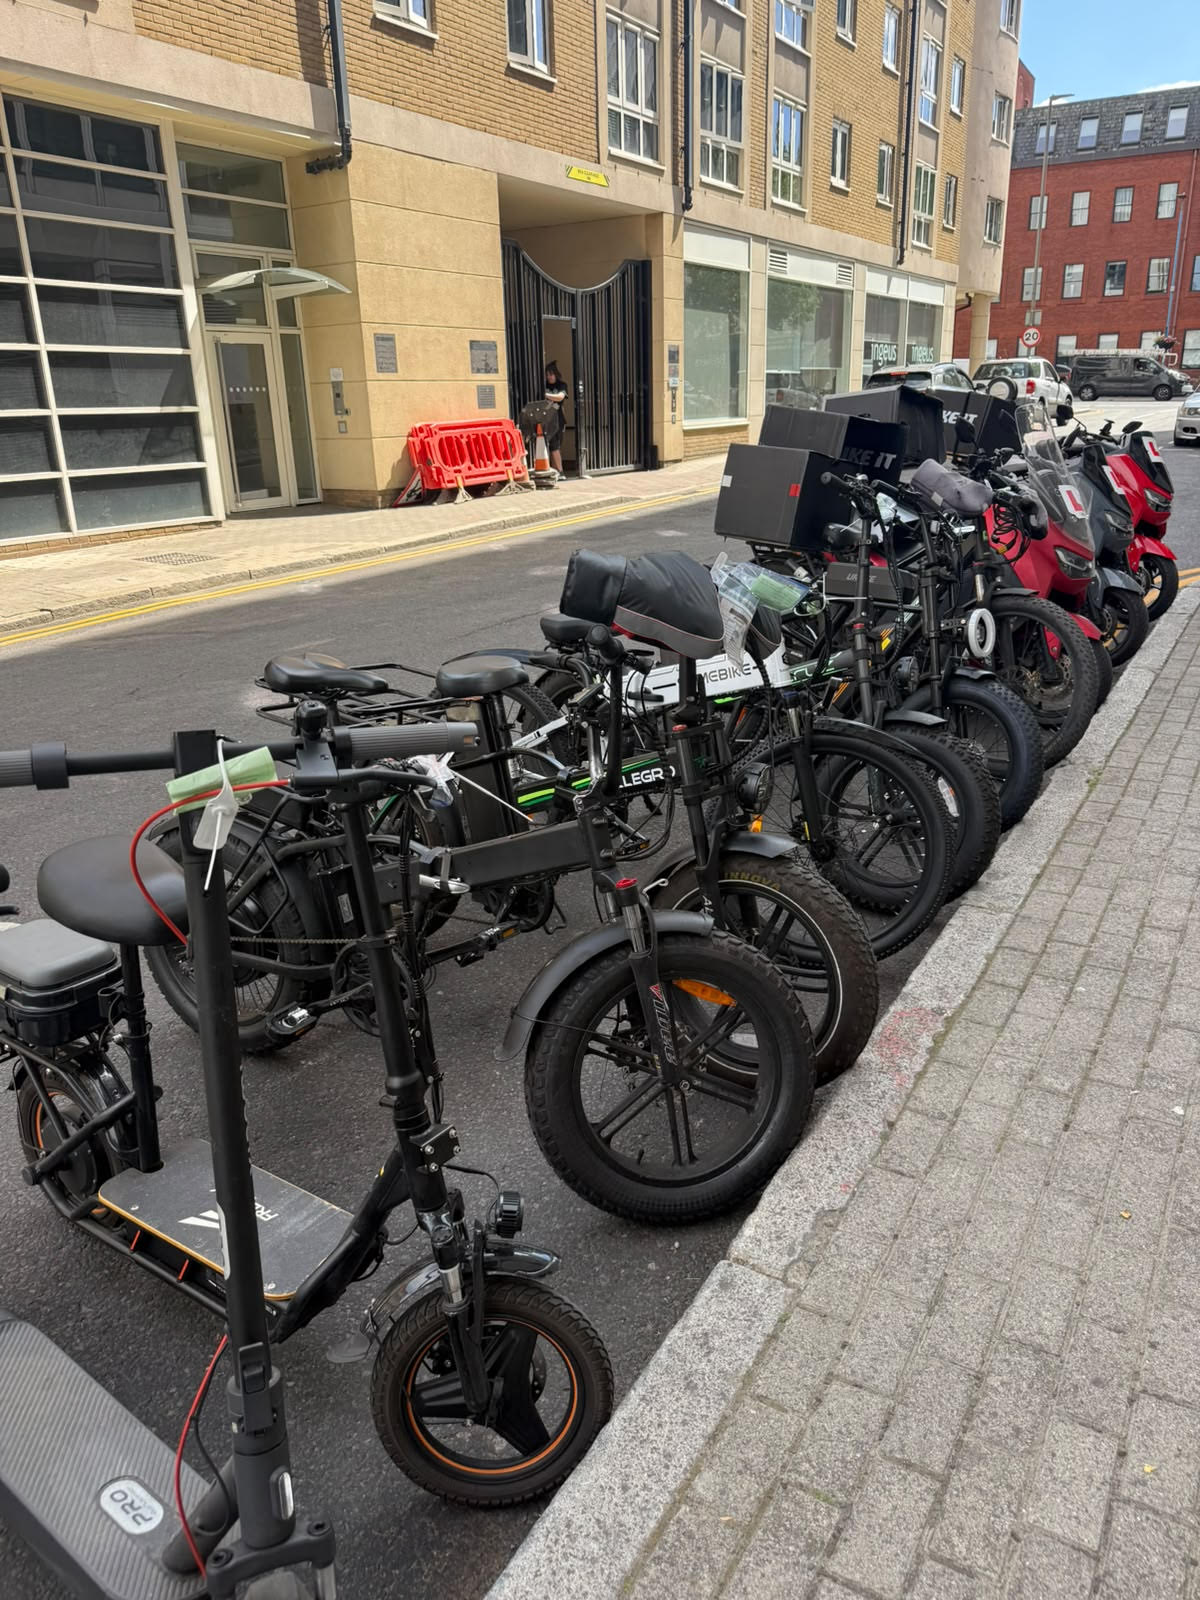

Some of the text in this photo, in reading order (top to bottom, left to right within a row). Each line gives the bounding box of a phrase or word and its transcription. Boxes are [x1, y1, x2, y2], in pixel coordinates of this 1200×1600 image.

[1024, 332, 1039, 341] 20
[1065, 489, 1084, 512] L
[110, 1489, 153, 1526] PRO
